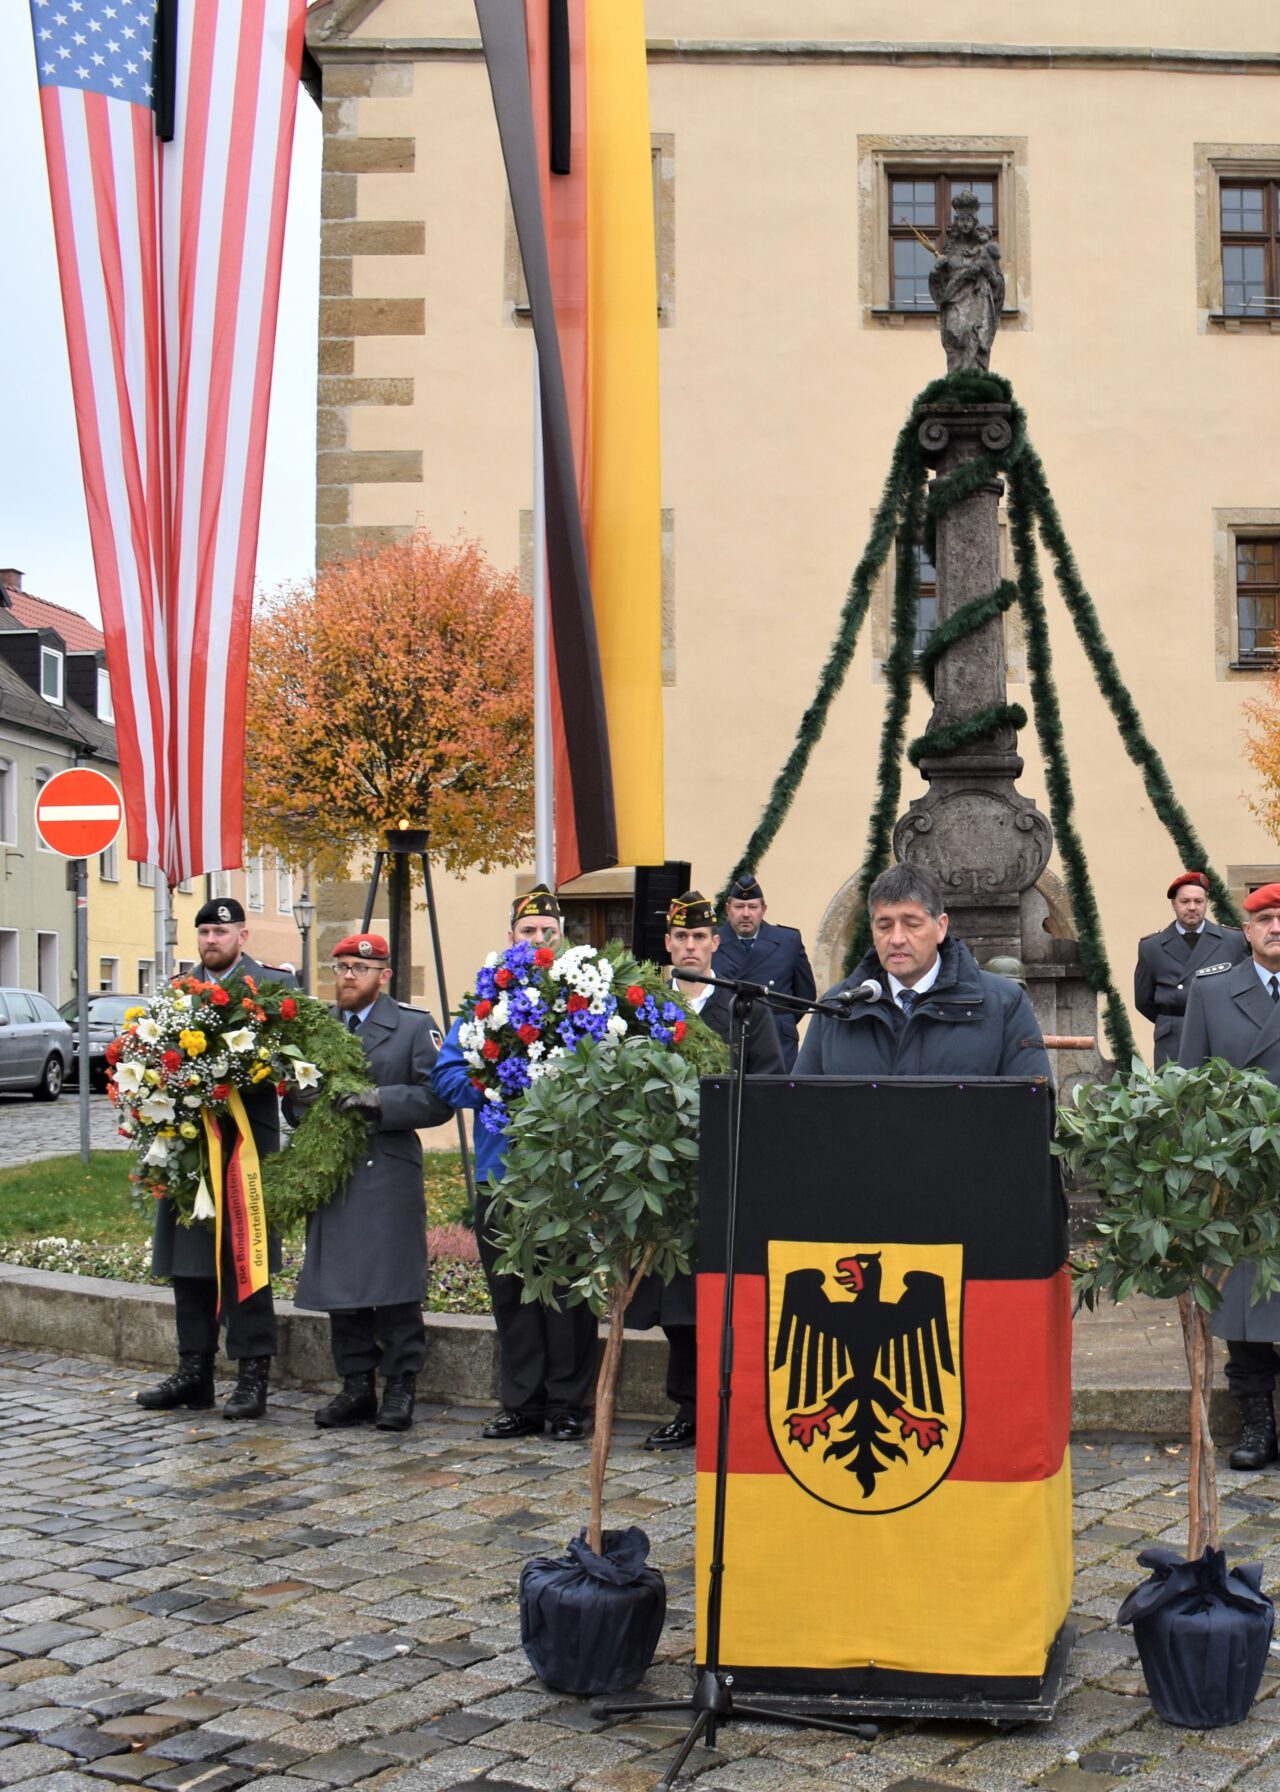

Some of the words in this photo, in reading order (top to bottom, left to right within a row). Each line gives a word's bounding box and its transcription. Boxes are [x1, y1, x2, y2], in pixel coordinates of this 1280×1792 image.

[230, 1162, 246, 1262] Bundesministerin
[247, 1172, 262, 1244] Verteidigung
[239, 1264, 248, 1284] Die
[253, 1250, 263, 1267] der
